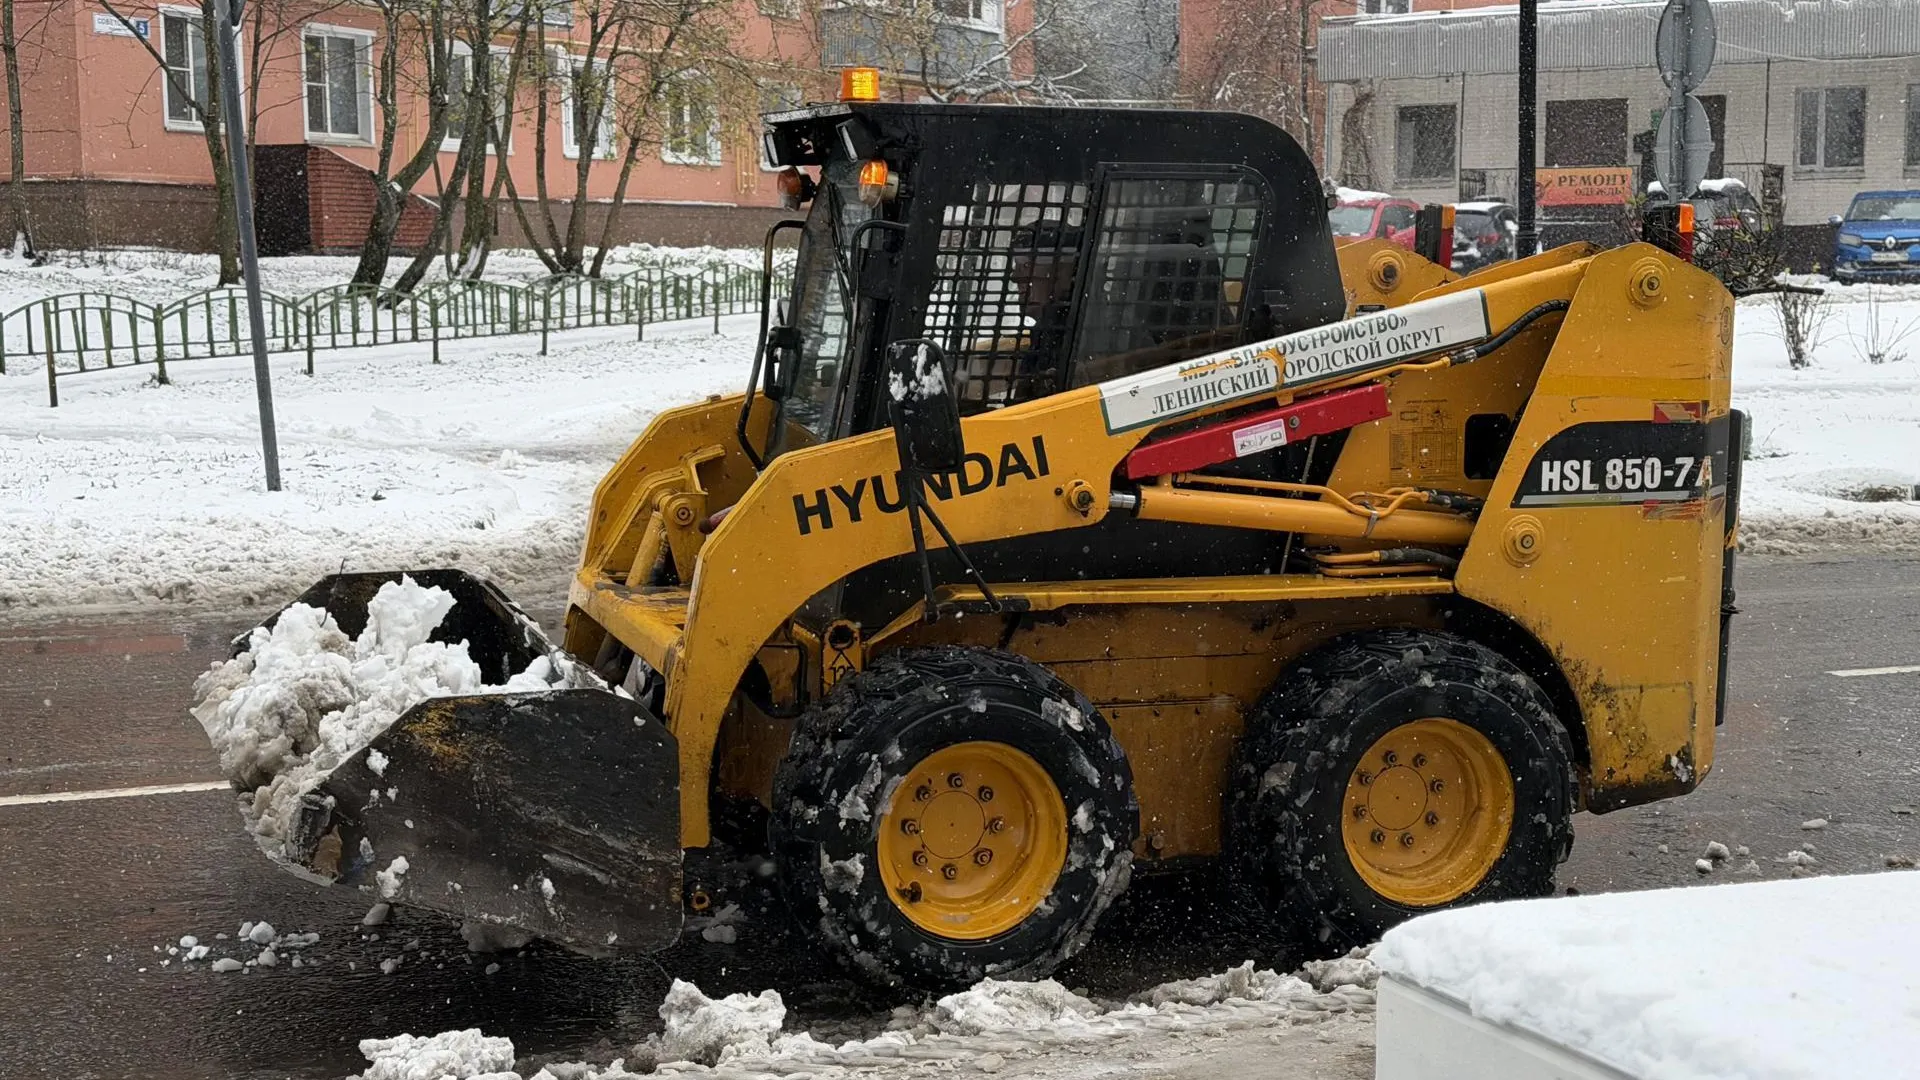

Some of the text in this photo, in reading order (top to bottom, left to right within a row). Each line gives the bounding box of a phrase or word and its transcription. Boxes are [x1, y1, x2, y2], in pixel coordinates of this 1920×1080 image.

[1558, 174, 1626, 187] РЕМОНТ
[1152, 363, 1271, 415] ЛЕНИНСКИЙ
[1386, 325, 1445, 355] ОКРУГ
[1541, 459, 1600, 492] HSL
